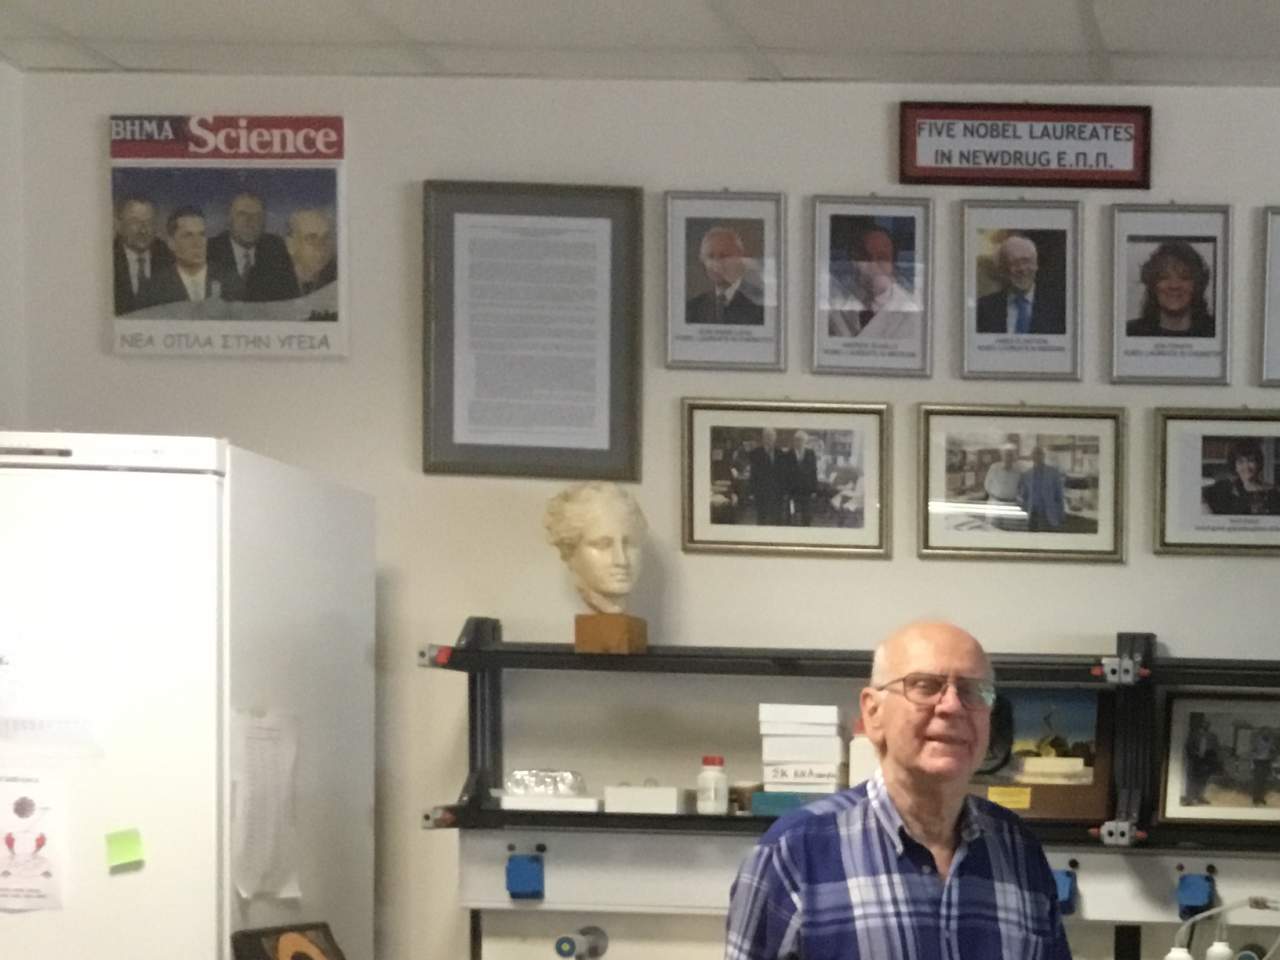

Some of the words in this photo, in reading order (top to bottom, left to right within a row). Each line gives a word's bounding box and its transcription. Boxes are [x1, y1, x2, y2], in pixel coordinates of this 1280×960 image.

[188, 115, 338, 154] Science
[917, 121, 955, 138] FIVE
[962, 122, 1022, 140] NOBEL
[1028, 123, 1134, 142] LAUREATES
[934, 149, 952, 165] IN
[958, 150, 1051, 167] NEWDRUG
